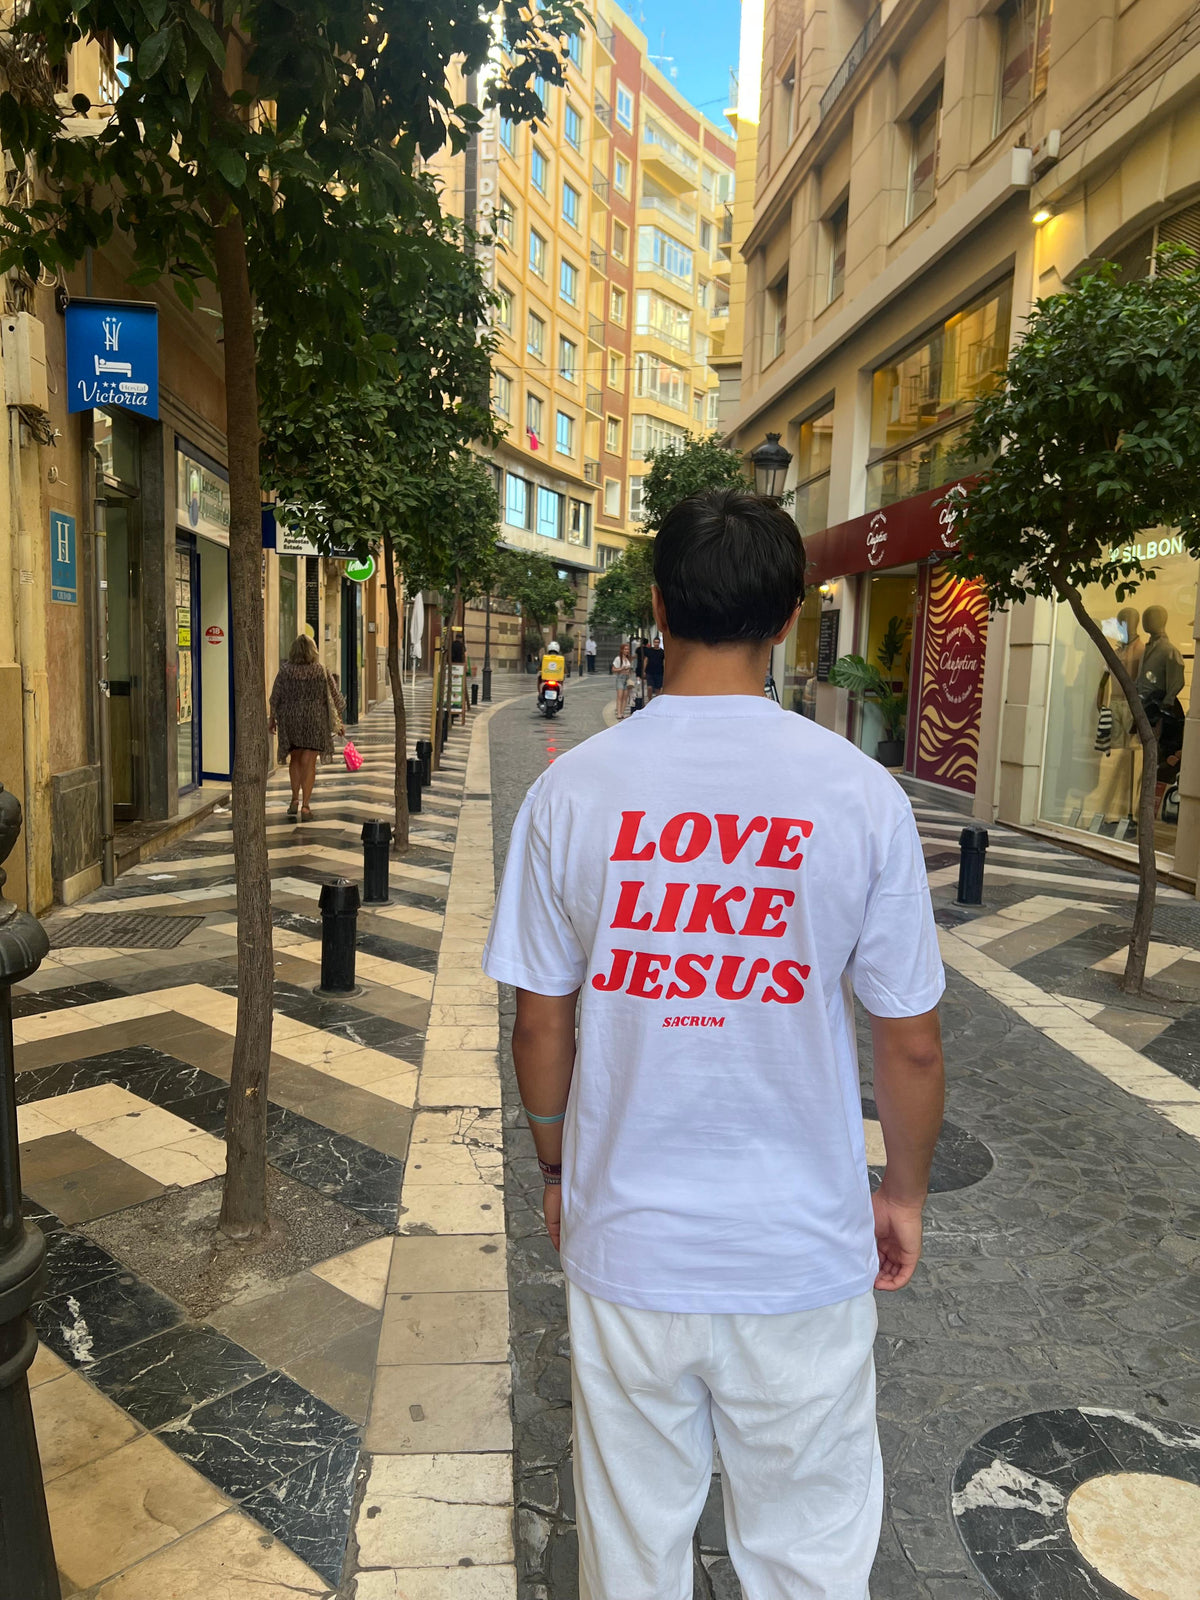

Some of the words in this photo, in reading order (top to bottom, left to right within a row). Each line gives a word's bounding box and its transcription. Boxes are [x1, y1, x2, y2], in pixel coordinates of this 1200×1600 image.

[77, 380, 148, 405] Victoria
[1122, 536, 1183, 563] SILBON
[610, 811, 813, 870] LOVE
[610, 881, 795, 938] LIKE
[592, 949, 811, 1005] JESUS
[662, 1016, 725, 1028] SACRUM
